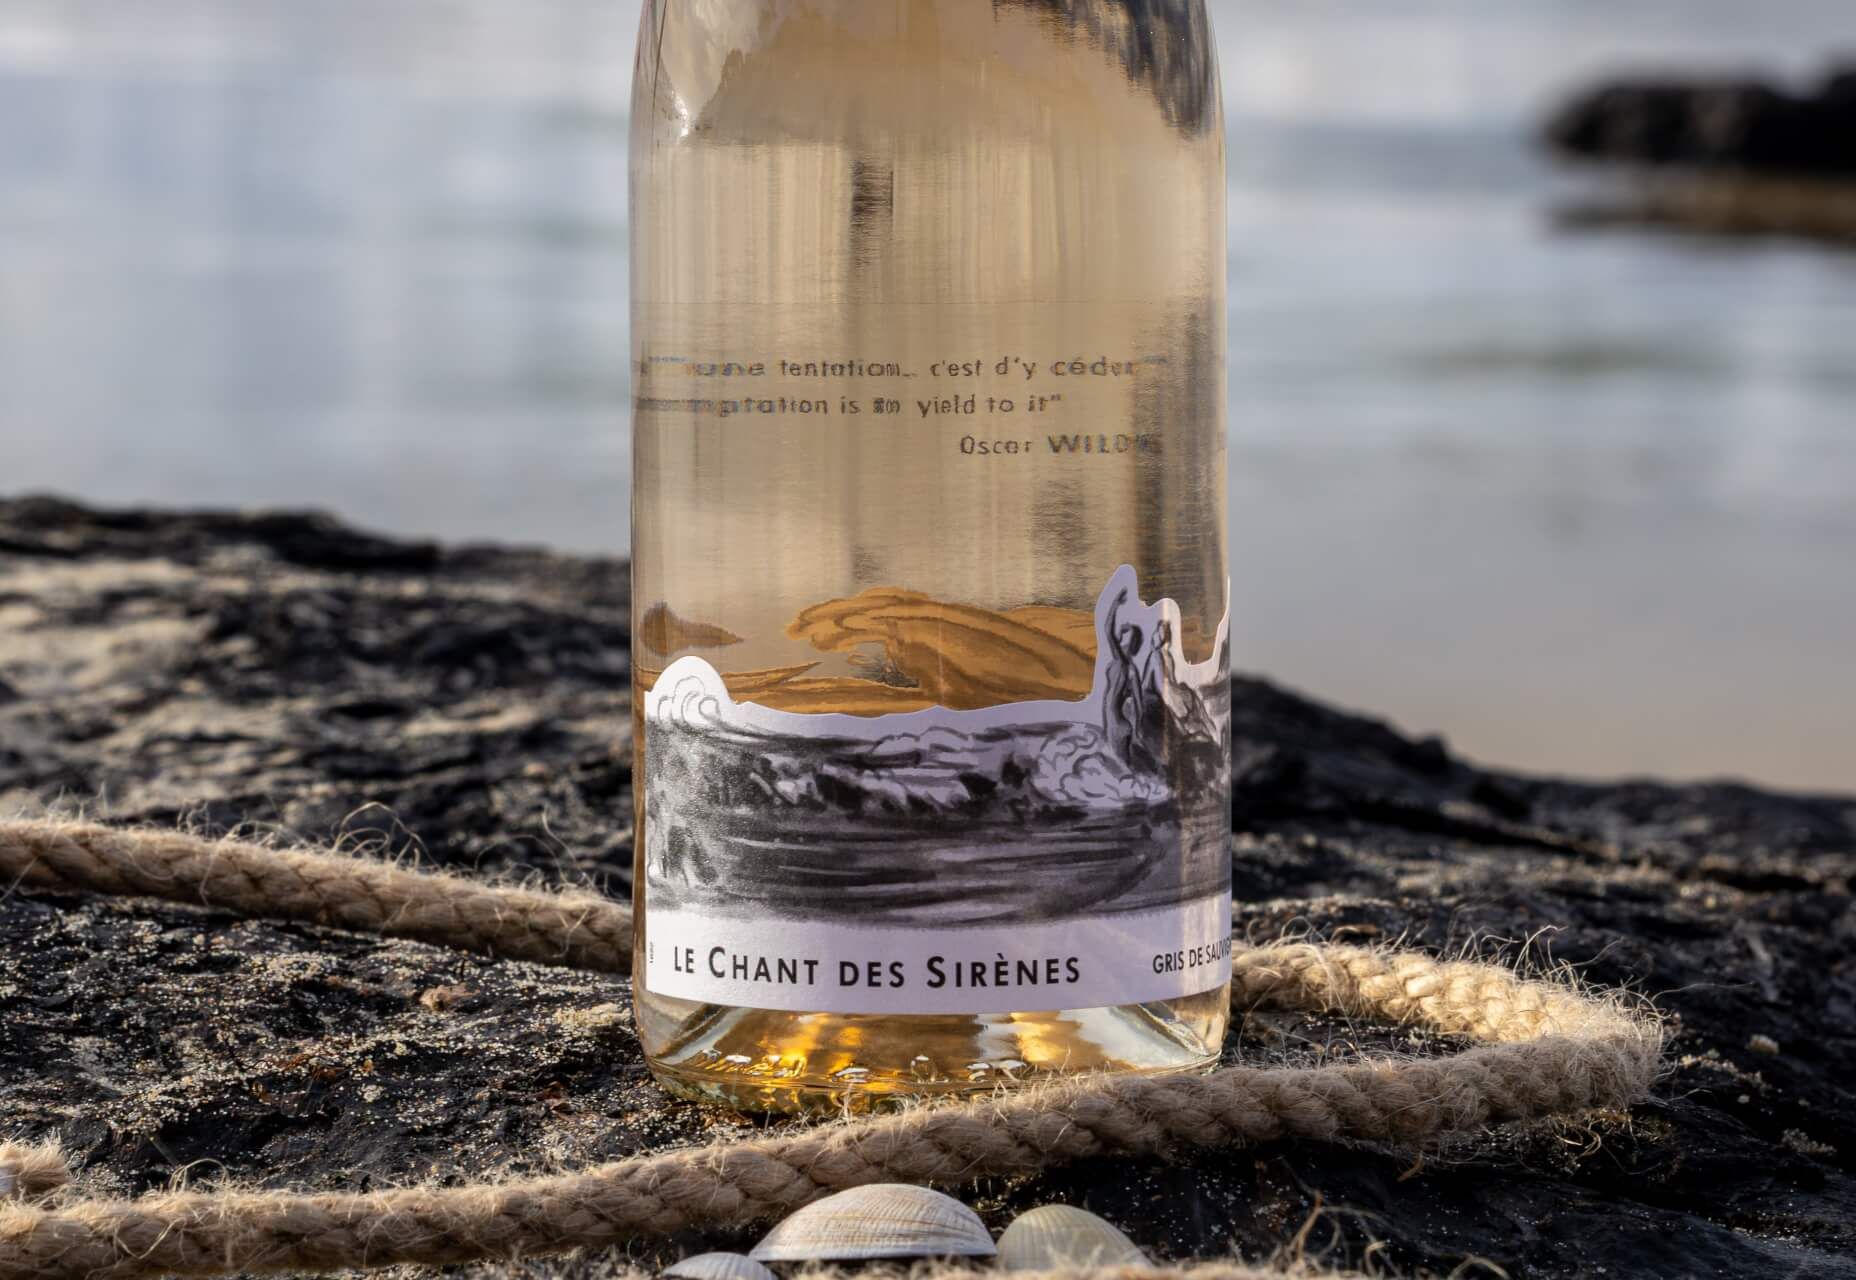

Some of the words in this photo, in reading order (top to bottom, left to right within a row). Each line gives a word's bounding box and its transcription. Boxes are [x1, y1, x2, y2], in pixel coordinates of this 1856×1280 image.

[929, 359, 982, 377] c'est
[995, 355, 1036, 380] d'y
[840, 396, 861, 414] is
[917, 394, 976, 418] yield
[986, 397, 1015, 413] to
[960, 435, 1032, 455] Oscar
[674, 945, 695, 974] LE
[839, 960, 905, 988] DES
[1152, 950, 1185, 975] GRIS
[1189, 946, 1203, 969] DE
